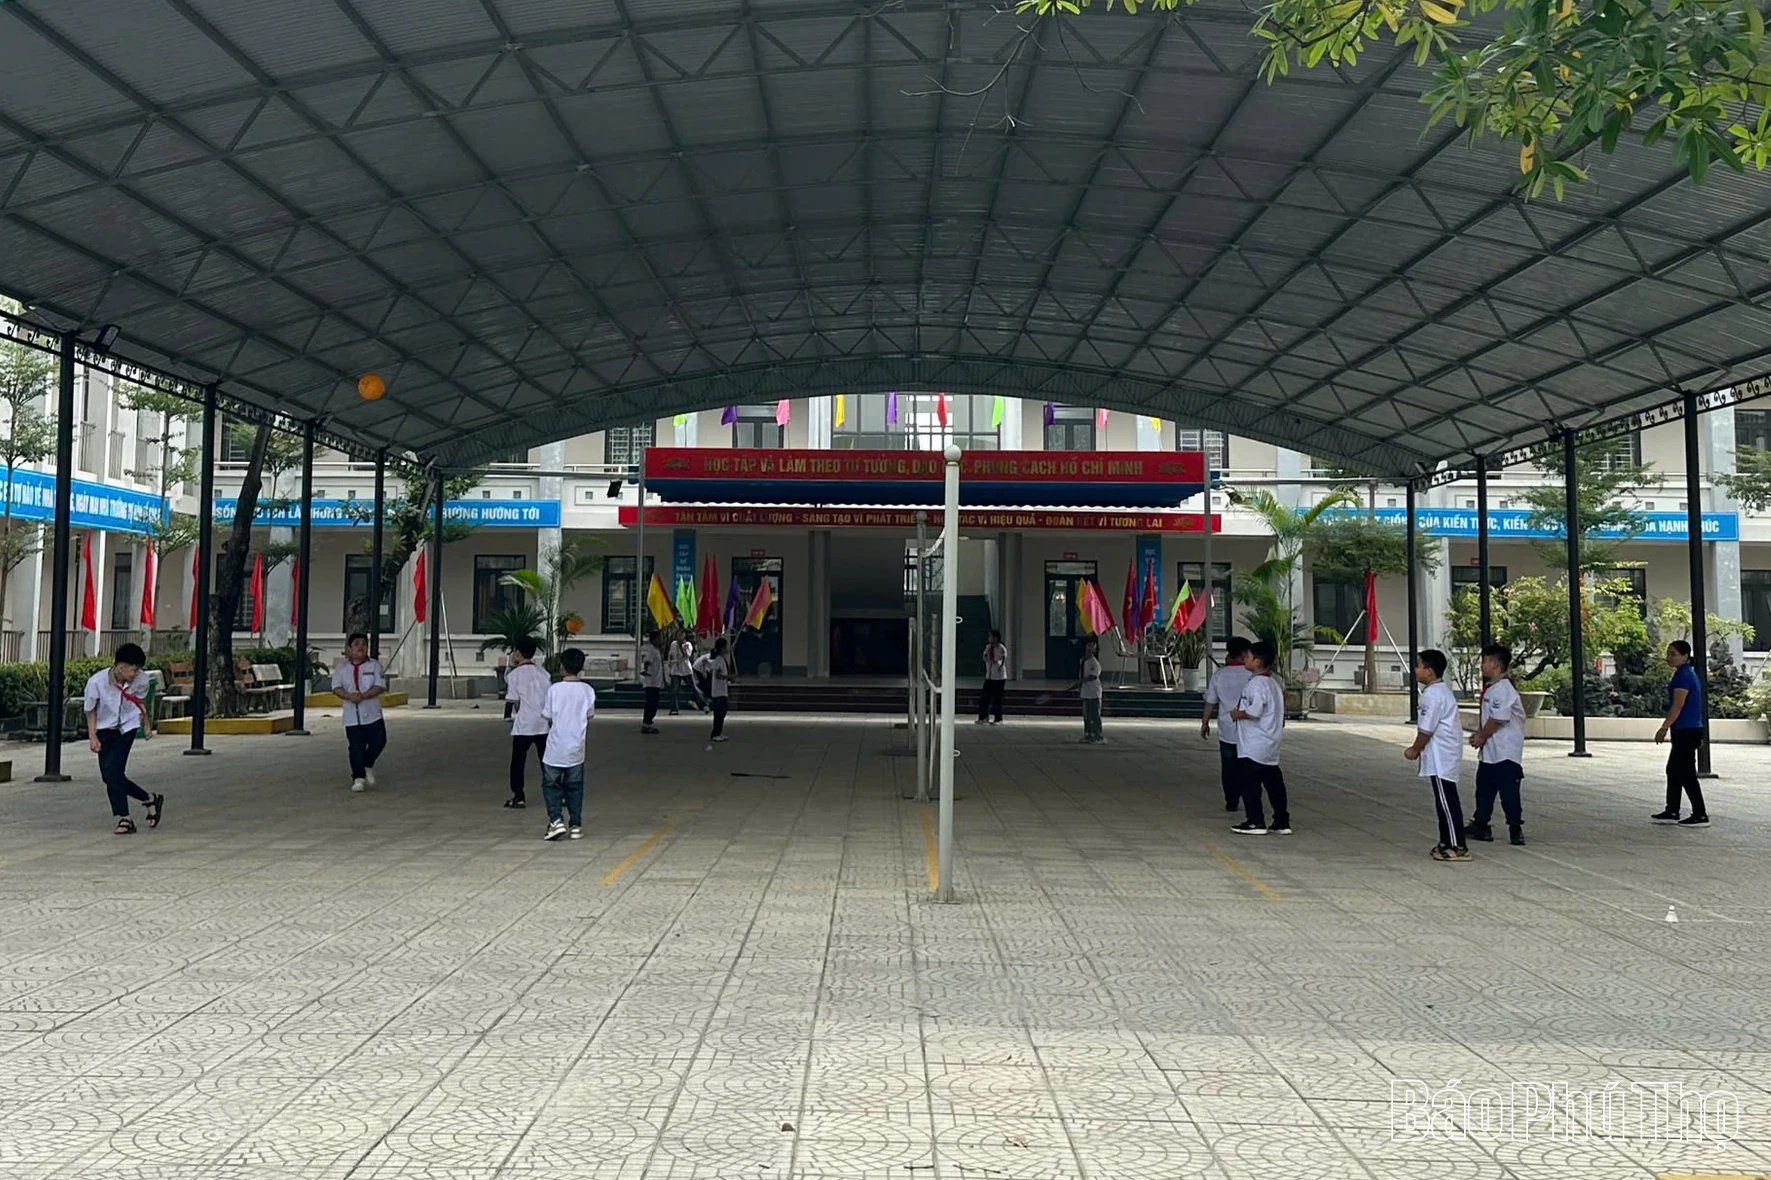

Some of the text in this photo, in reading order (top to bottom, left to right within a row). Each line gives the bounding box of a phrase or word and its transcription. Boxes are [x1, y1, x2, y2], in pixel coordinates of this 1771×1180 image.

[760, 455, 775, 473] VÀ
[779, 455, 806, 473] LÀM
[810, 459, 840, 473] THEO
[1108, 461, 1143, 475] MINH
[215, 503, 237, 519] SỐN
[481, 505, 519, 520] HƯỚNG
[522, 506, 540, 520] TỚI
[1146, 517, 1163, 528] LAI
[1442, 512, 1468, 529] KIẾN
